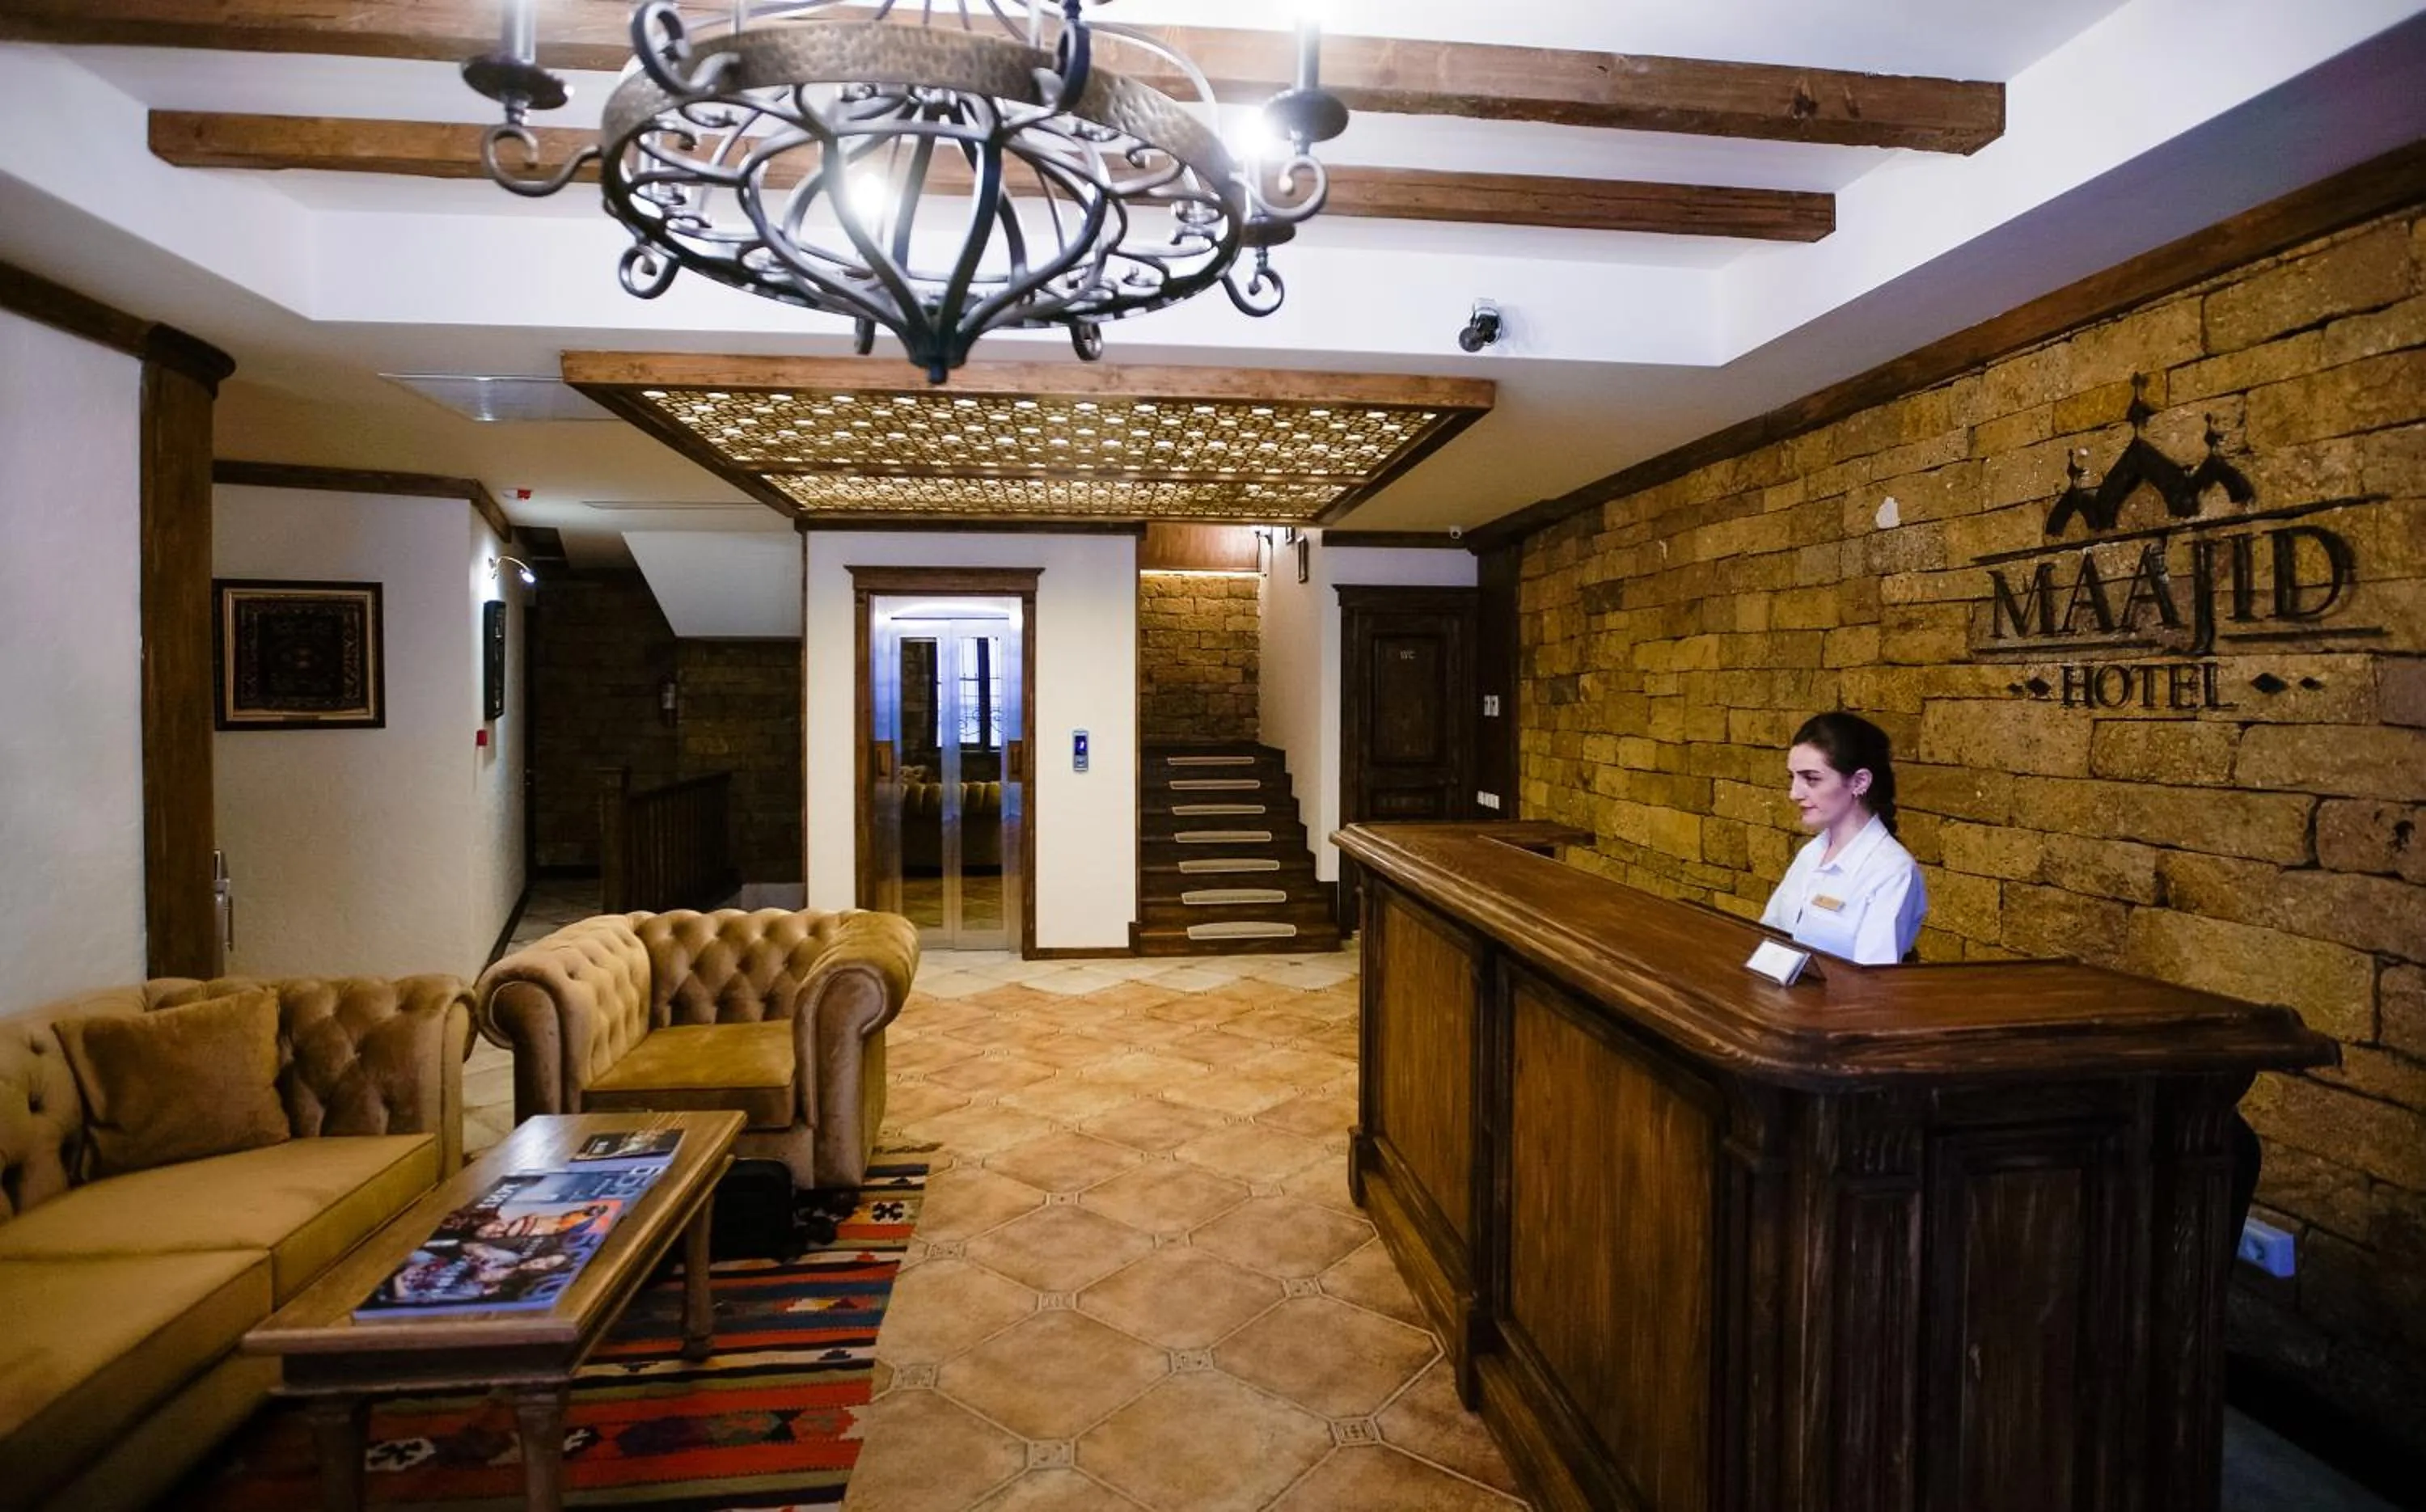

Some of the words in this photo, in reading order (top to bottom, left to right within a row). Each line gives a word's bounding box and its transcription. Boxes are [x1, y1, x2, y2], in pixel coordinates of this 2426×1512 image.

[1987, 525, 2356, 657] MAAJID
[1400, 649, 1417, 661] WC
[2060, 662, 2239, 710] HOTEL
